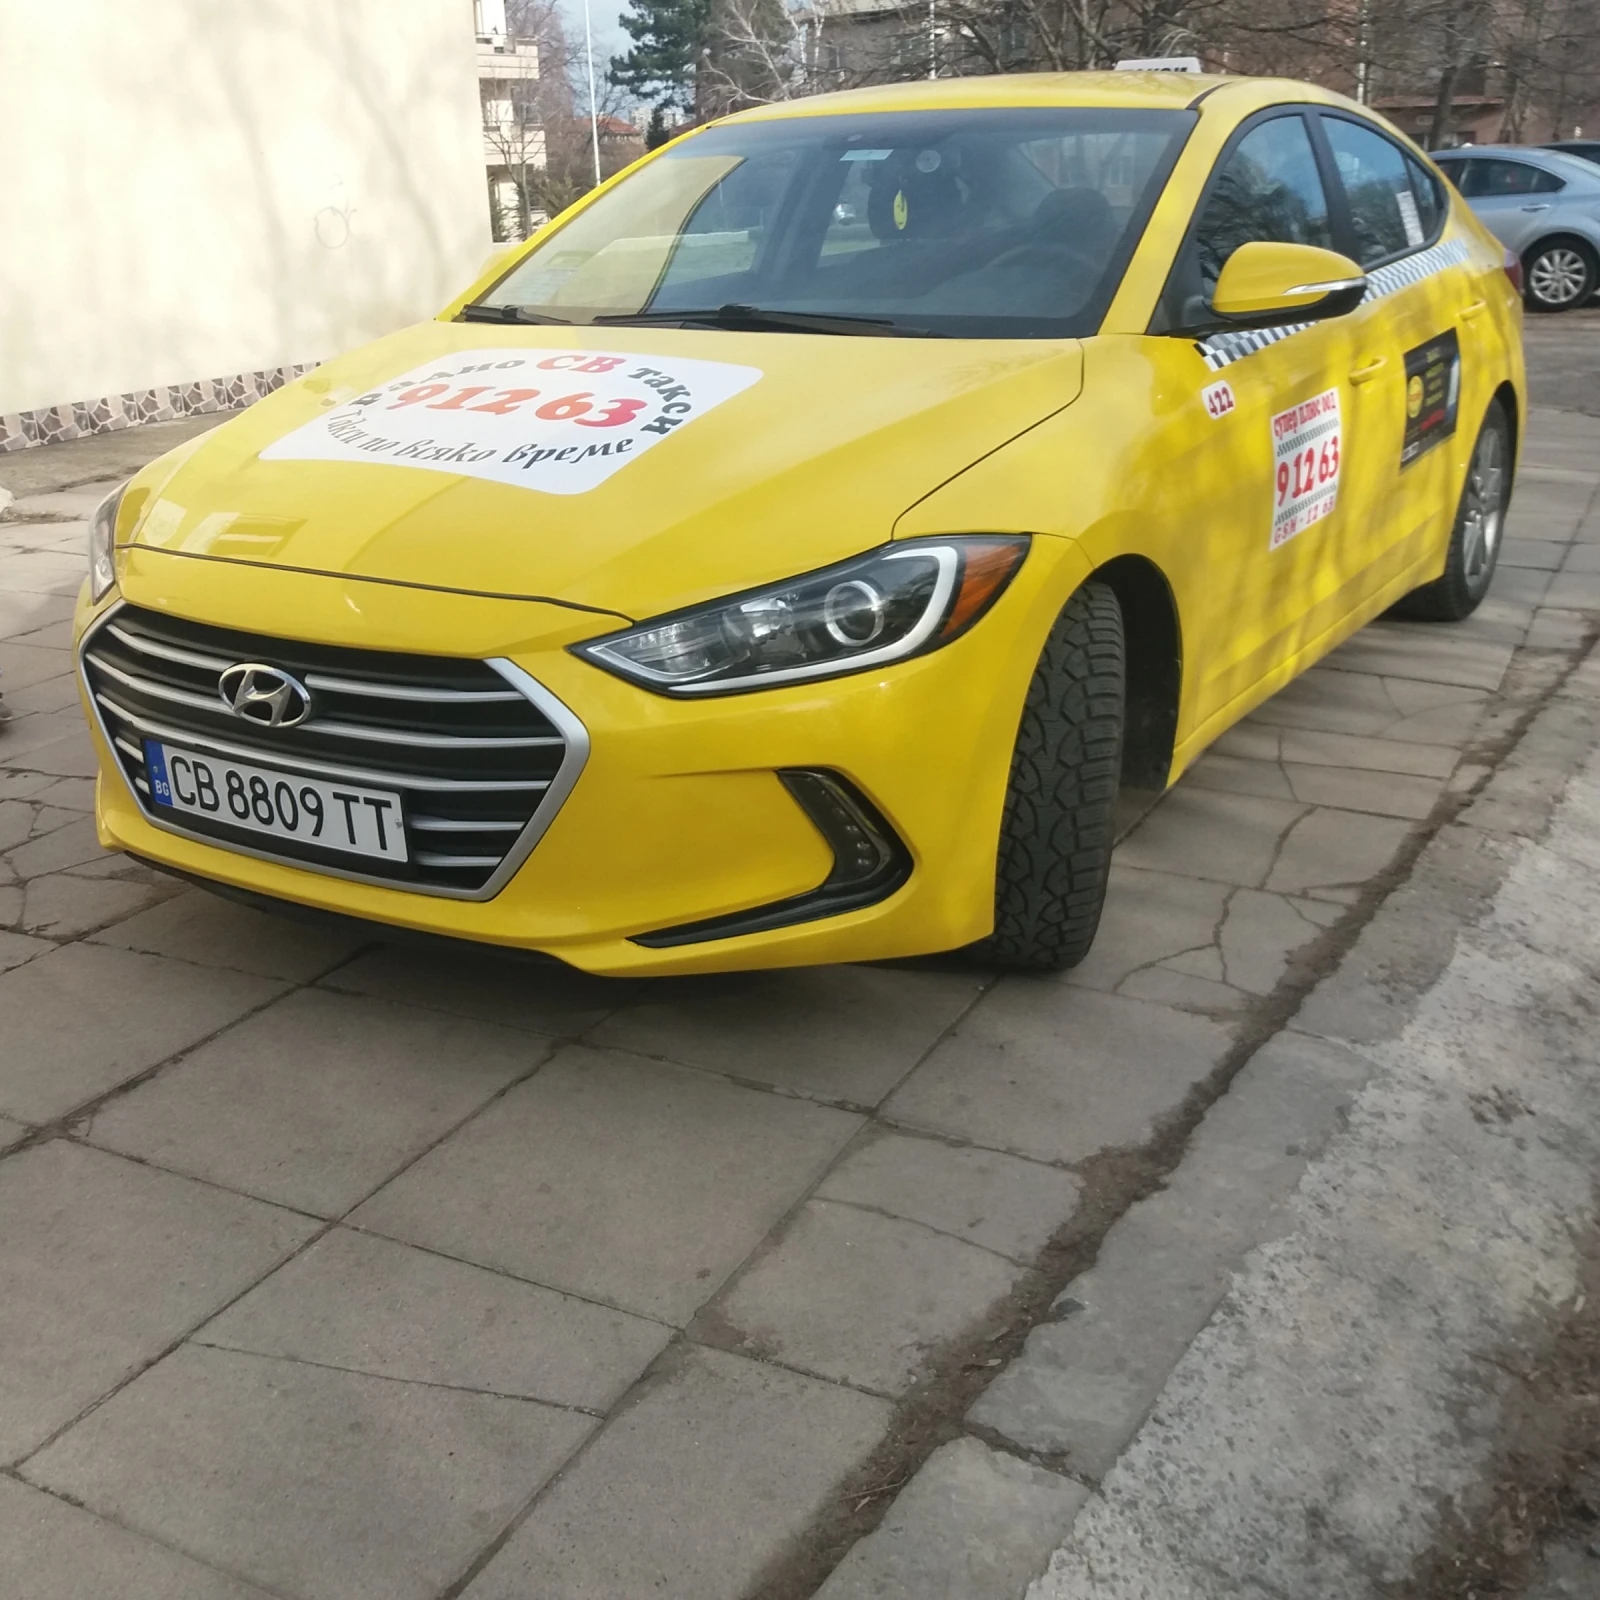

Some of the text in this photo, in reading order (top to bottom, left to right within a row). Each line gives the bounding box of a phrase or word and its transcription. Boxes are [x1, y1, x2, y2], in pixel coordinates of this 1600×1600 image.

[627, 366, 692, 435] такси
[1208, 386, 1235, 416] 422
[326, 409, 634, 470] Такси по всяко време
[154, 779, 170, 797] BG
[170, 755, 393, 851] CB 8809 TT
